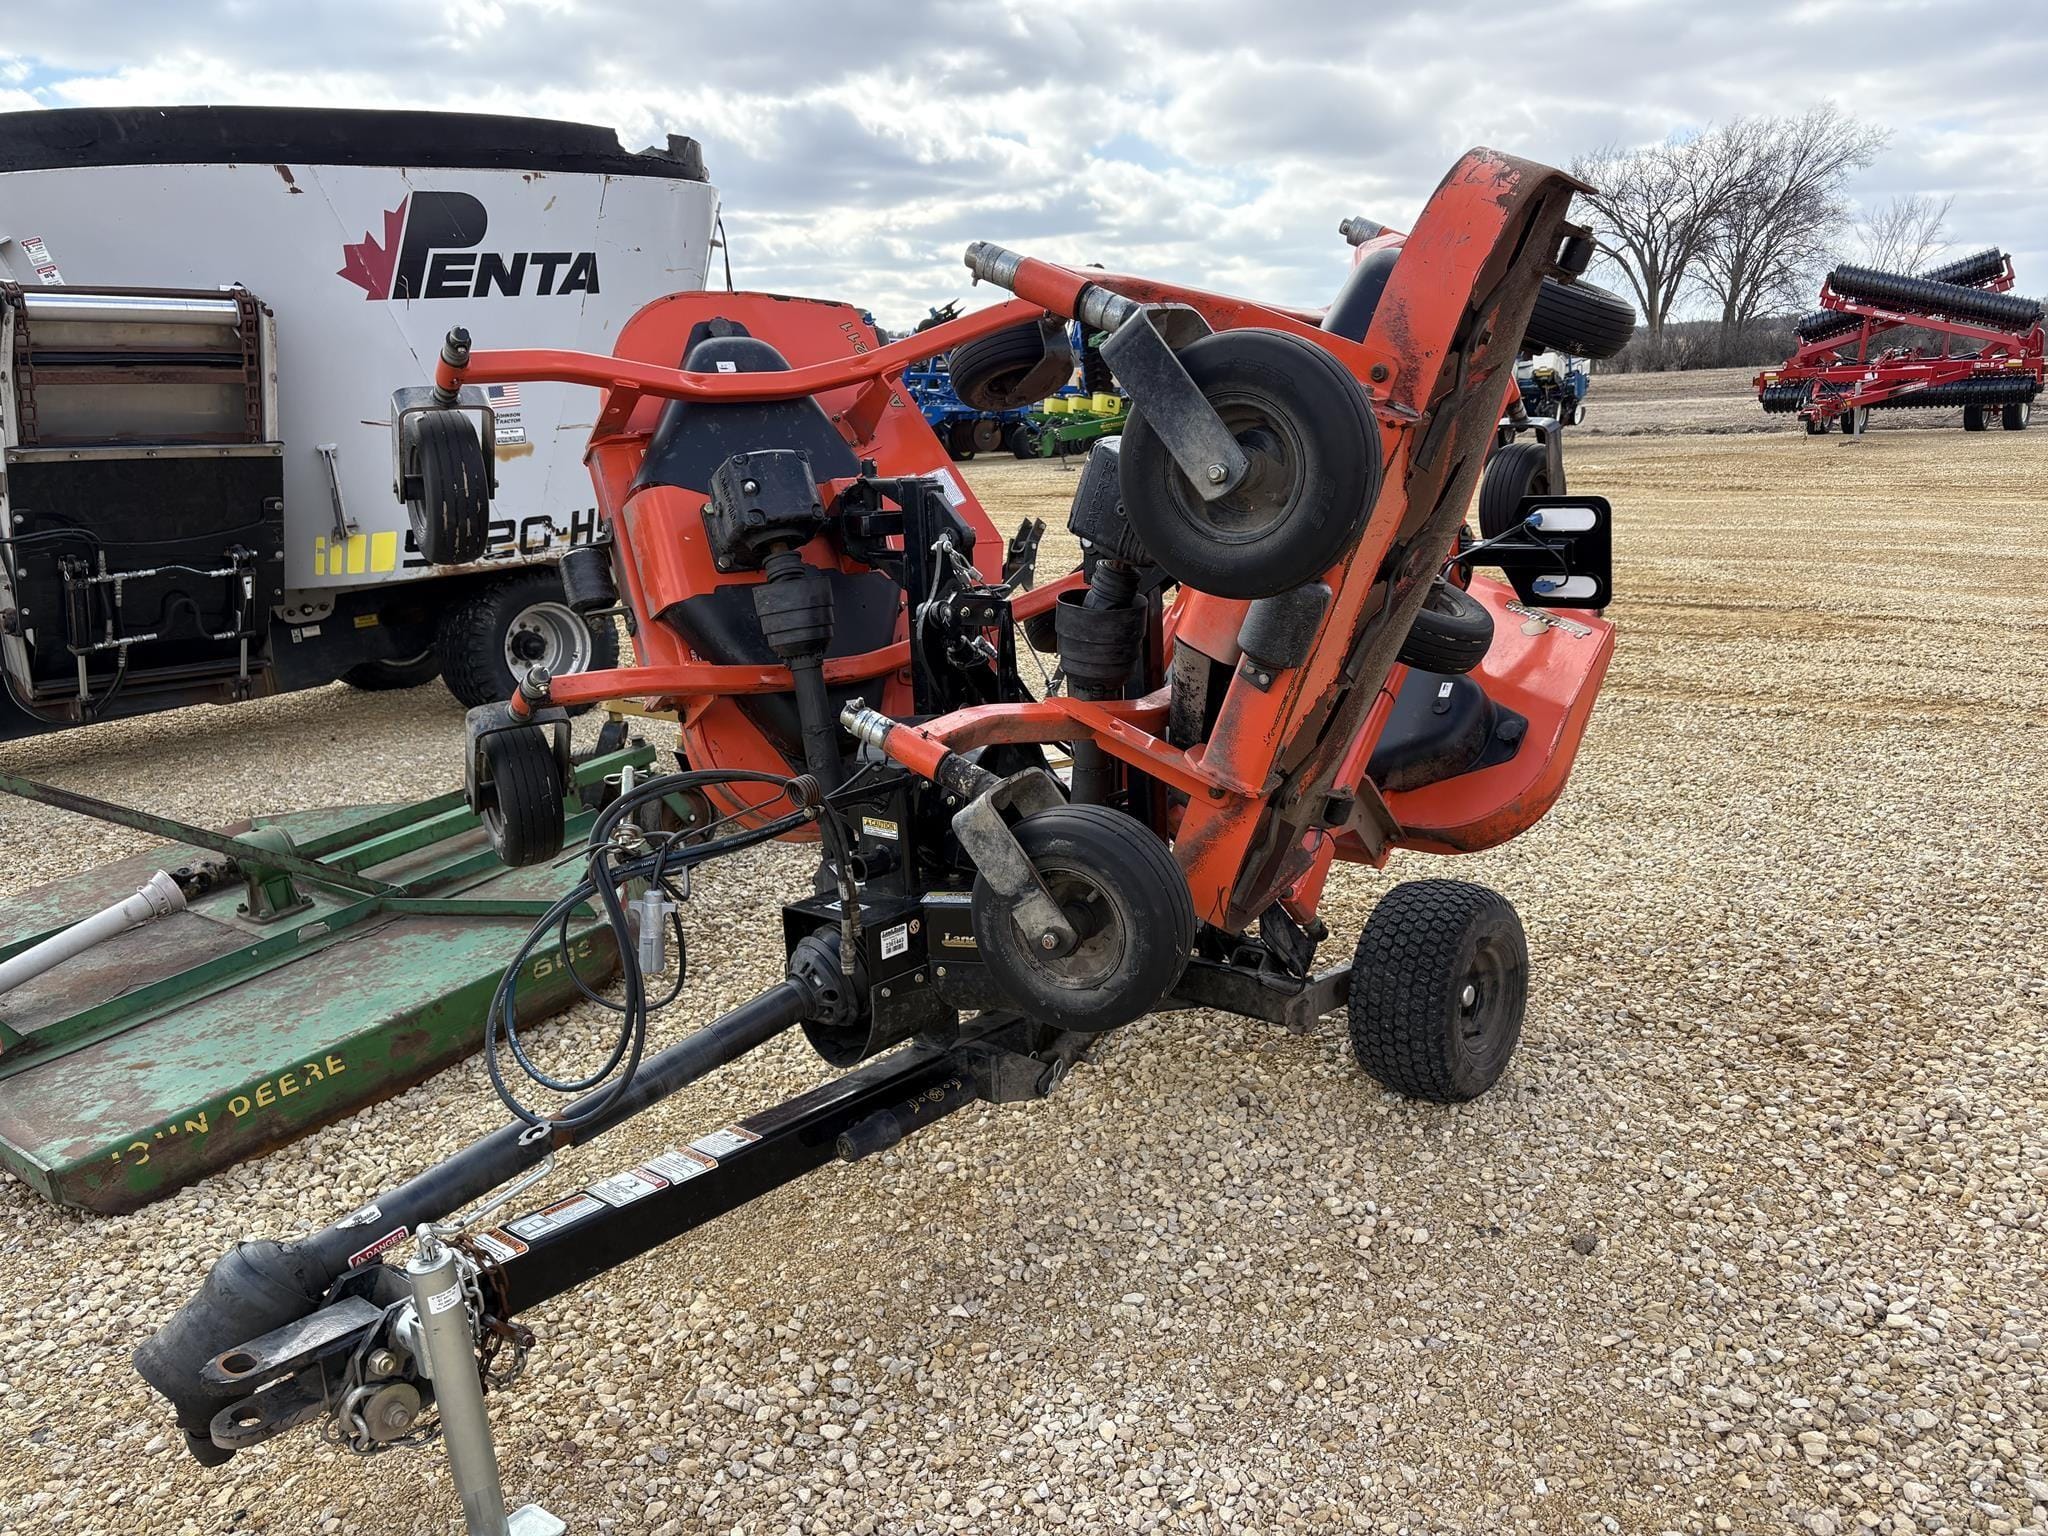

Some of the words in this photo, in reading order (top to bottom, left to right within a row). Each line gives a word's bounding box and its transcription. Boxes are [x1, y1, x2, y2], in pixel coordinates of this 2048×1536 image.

[391, 190, 601, 300] PENTA
[227, 1055, 347, 1119] DEERE
[366, 1231, 406, 1260] DANGER
